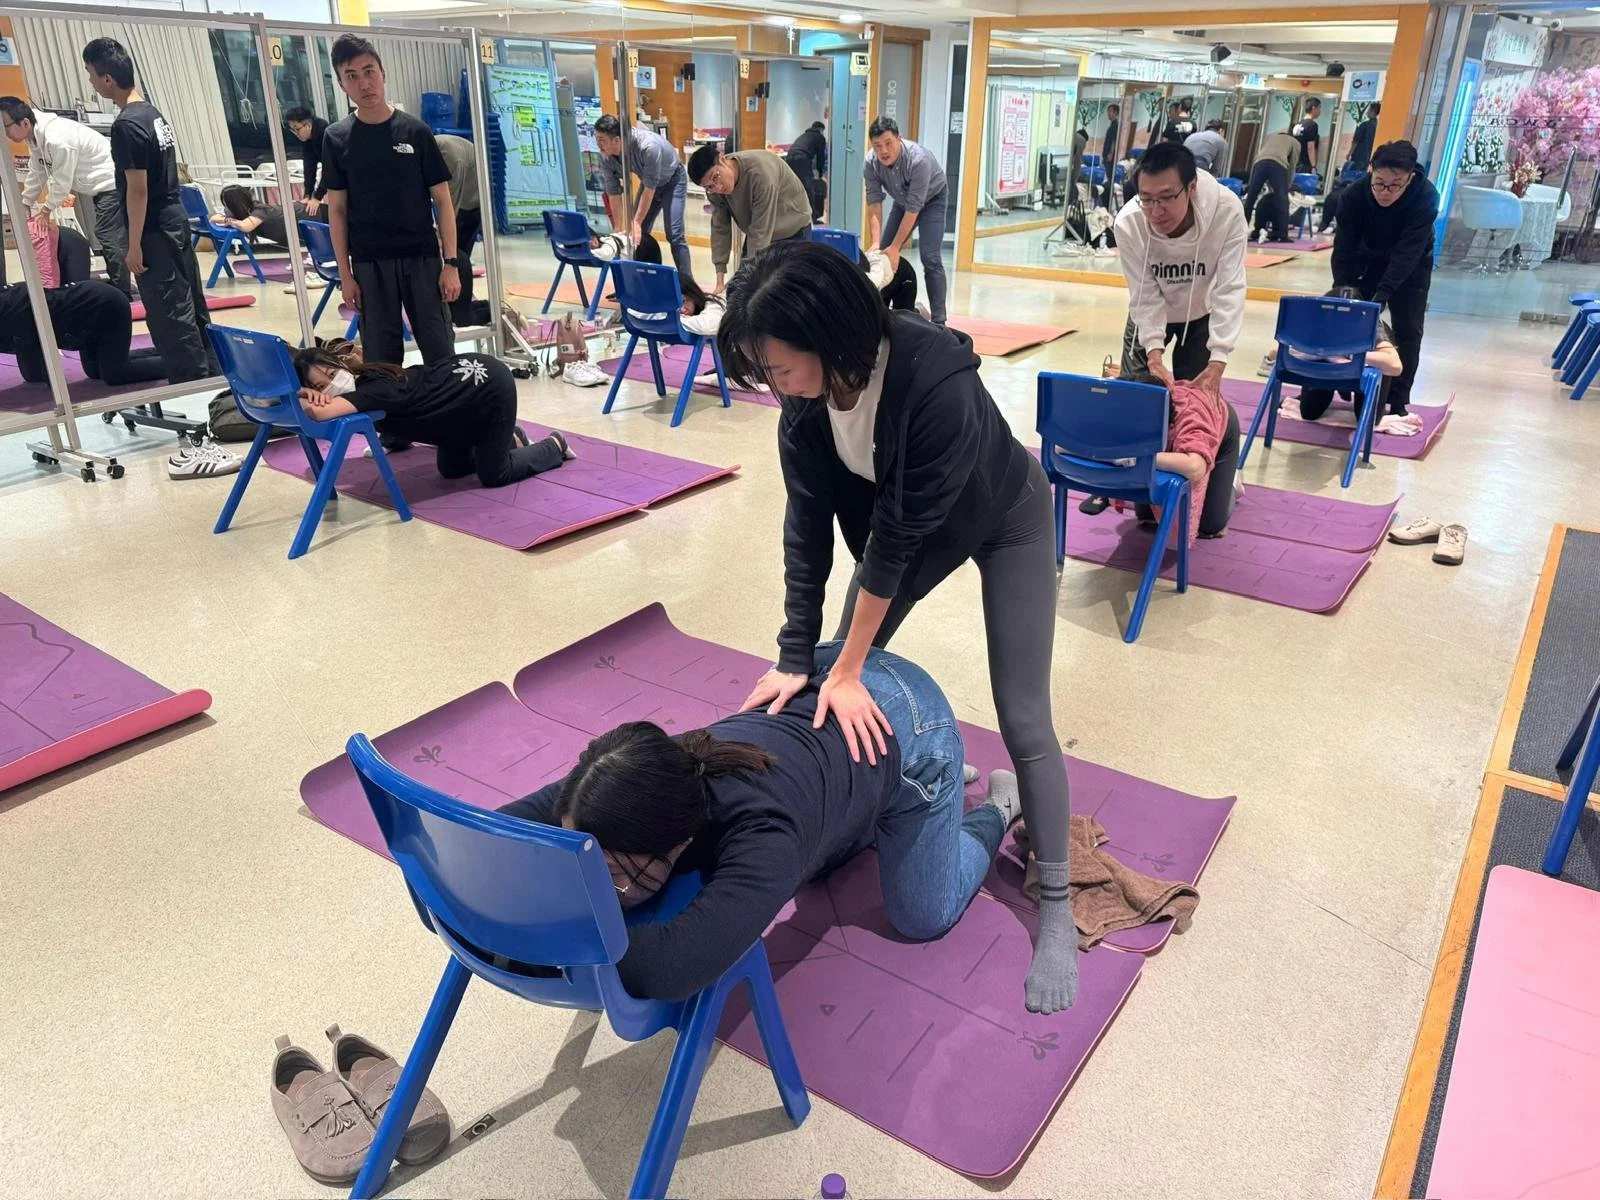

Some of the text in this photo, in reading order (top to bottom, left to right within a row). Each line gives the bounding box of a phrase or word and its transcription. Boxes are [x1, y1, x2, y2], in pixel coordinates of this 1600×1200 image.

[270, 45, 282, 60] 0
[481, 44, 494, 58] 11
[629, 56, 638, 68] 12
[741, 63, 749, 74] 13
